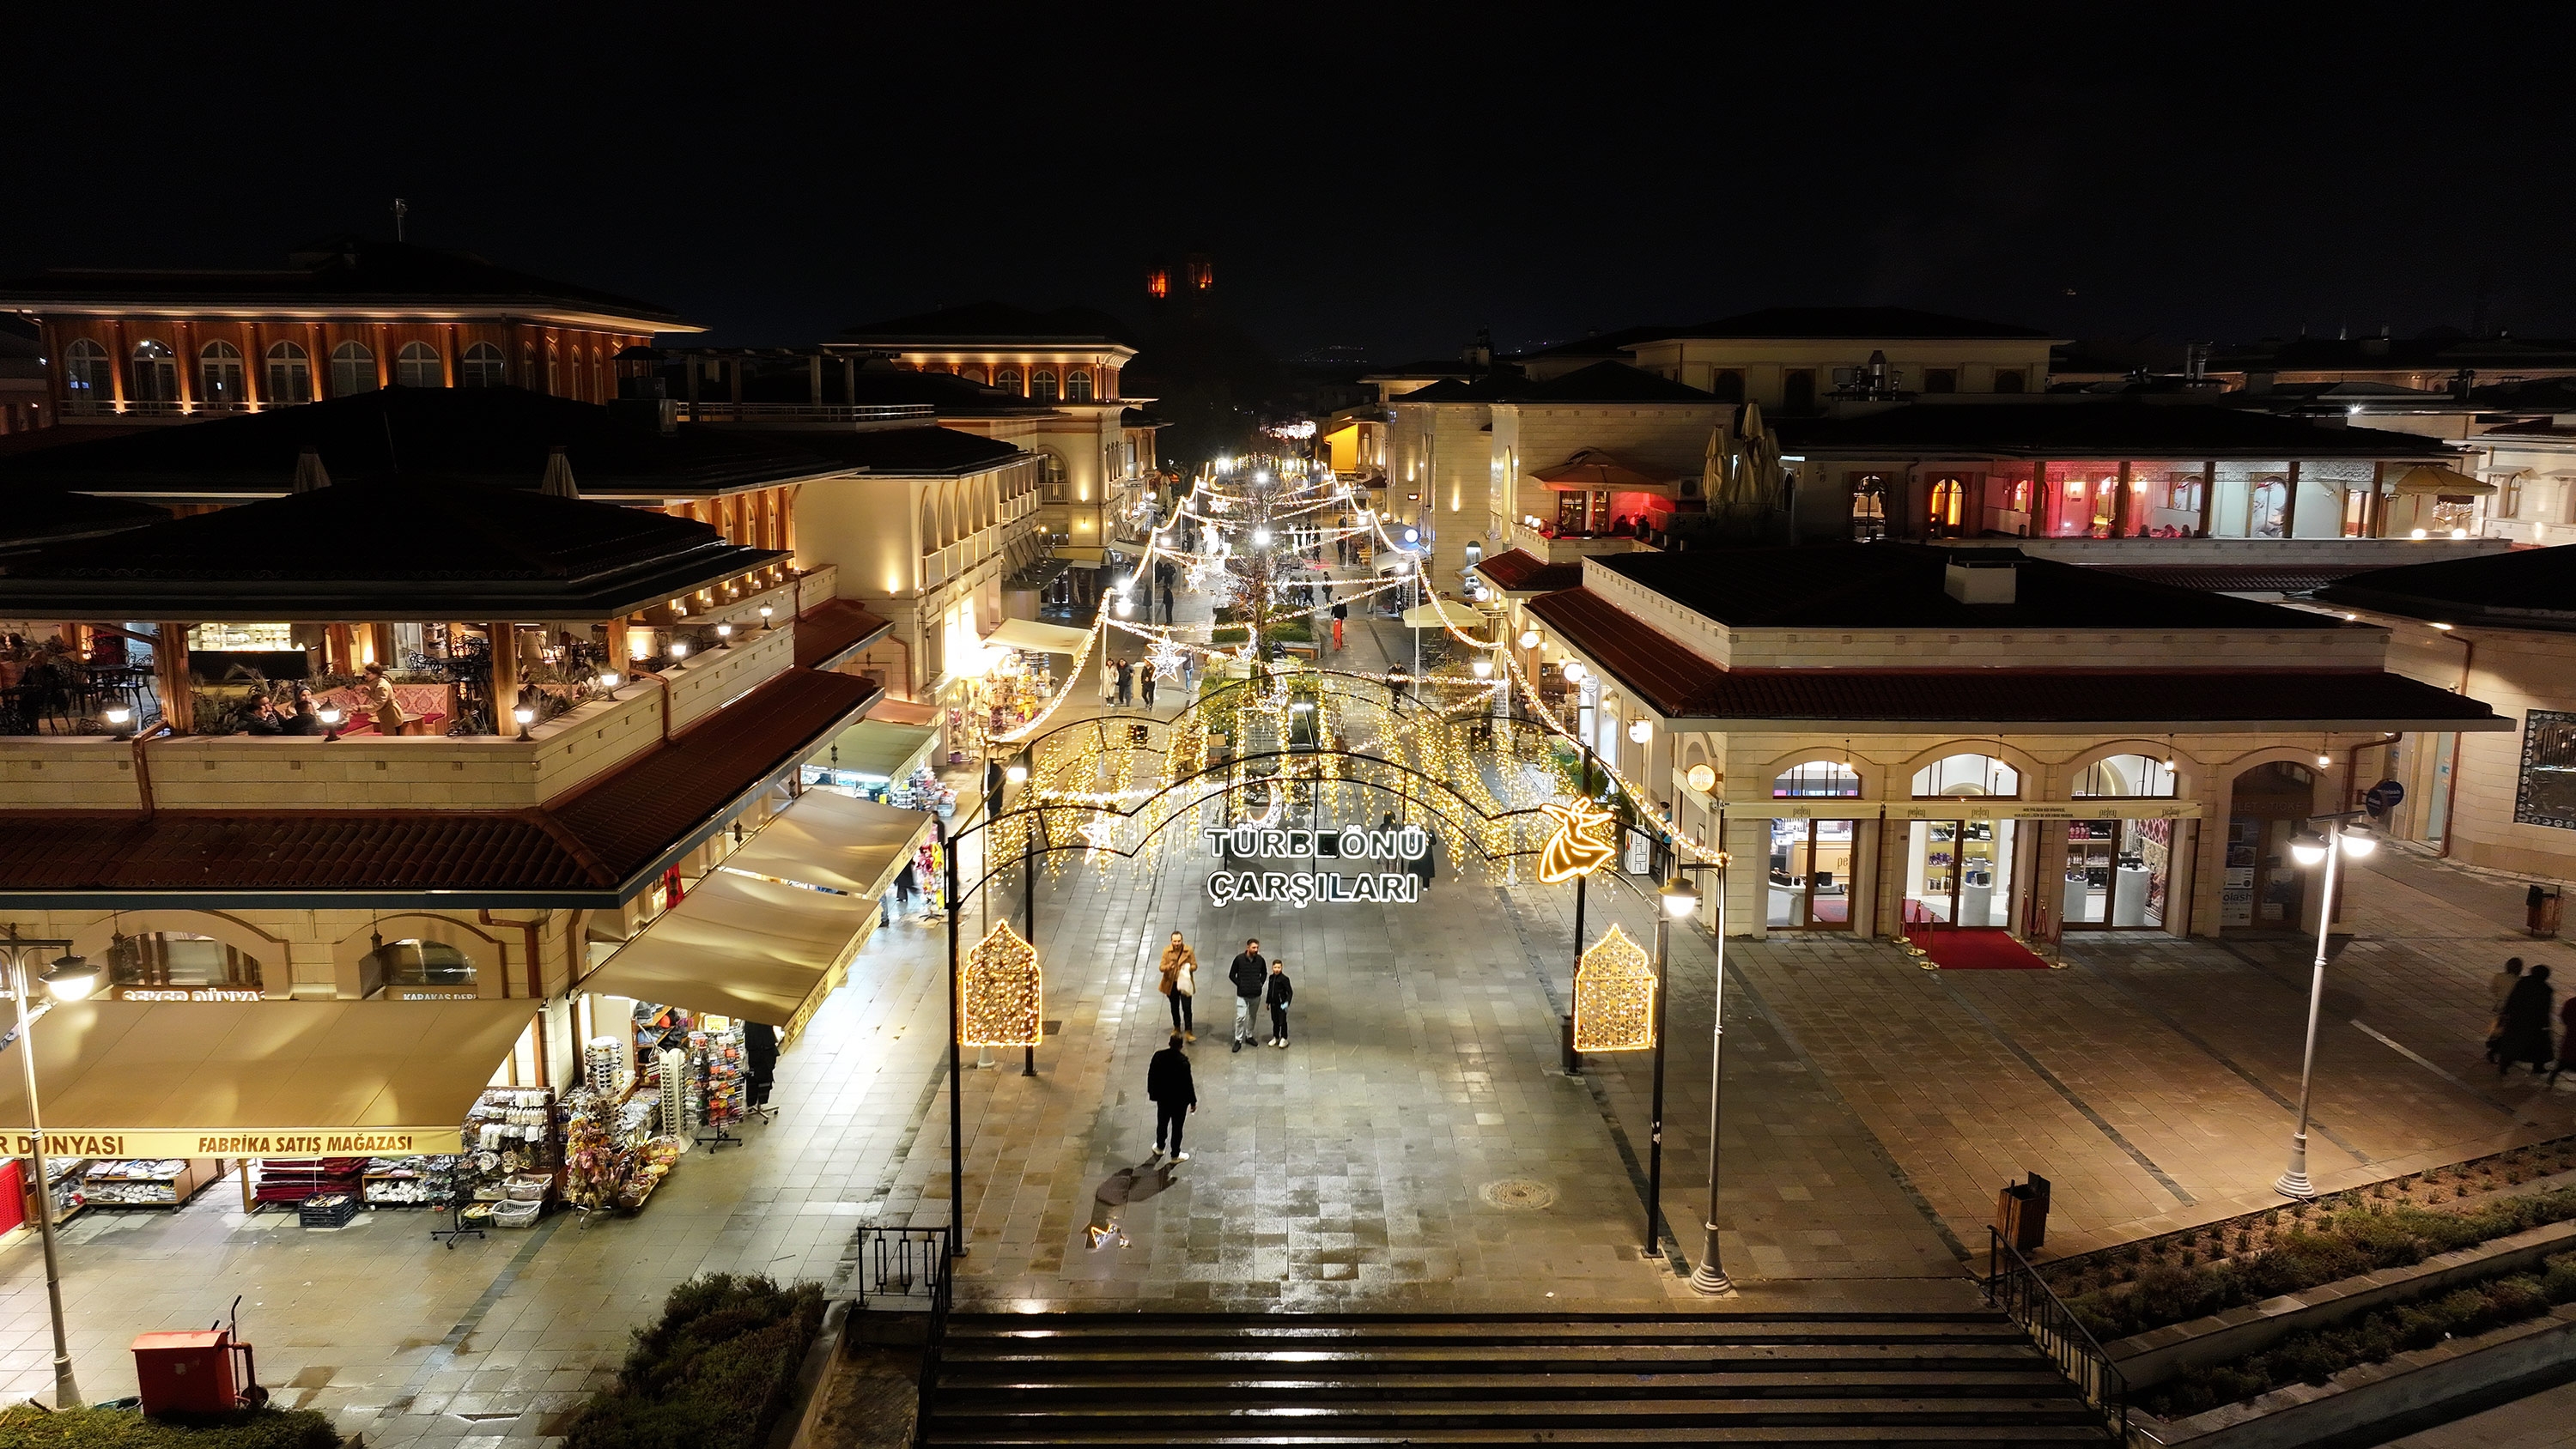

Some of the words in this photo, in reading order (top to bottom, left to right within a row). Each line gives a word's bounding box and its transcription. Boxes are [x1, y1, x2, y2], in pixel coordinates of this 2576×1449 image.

[1203, 824, 1427, 861] TÜRBEÖNÜ
[1206, 870, 1419, 908] ÇARŞILARI
[191, 987, 265, 1002] DÜNYA
[17, 1136, 124, 1155] DNYASI
[198, 1133, 270, 1153] FABRİKA
[275, 1136, 321, 1155] SATIŞ
[325, 1132, 413, 1152] MAĞAZASI
